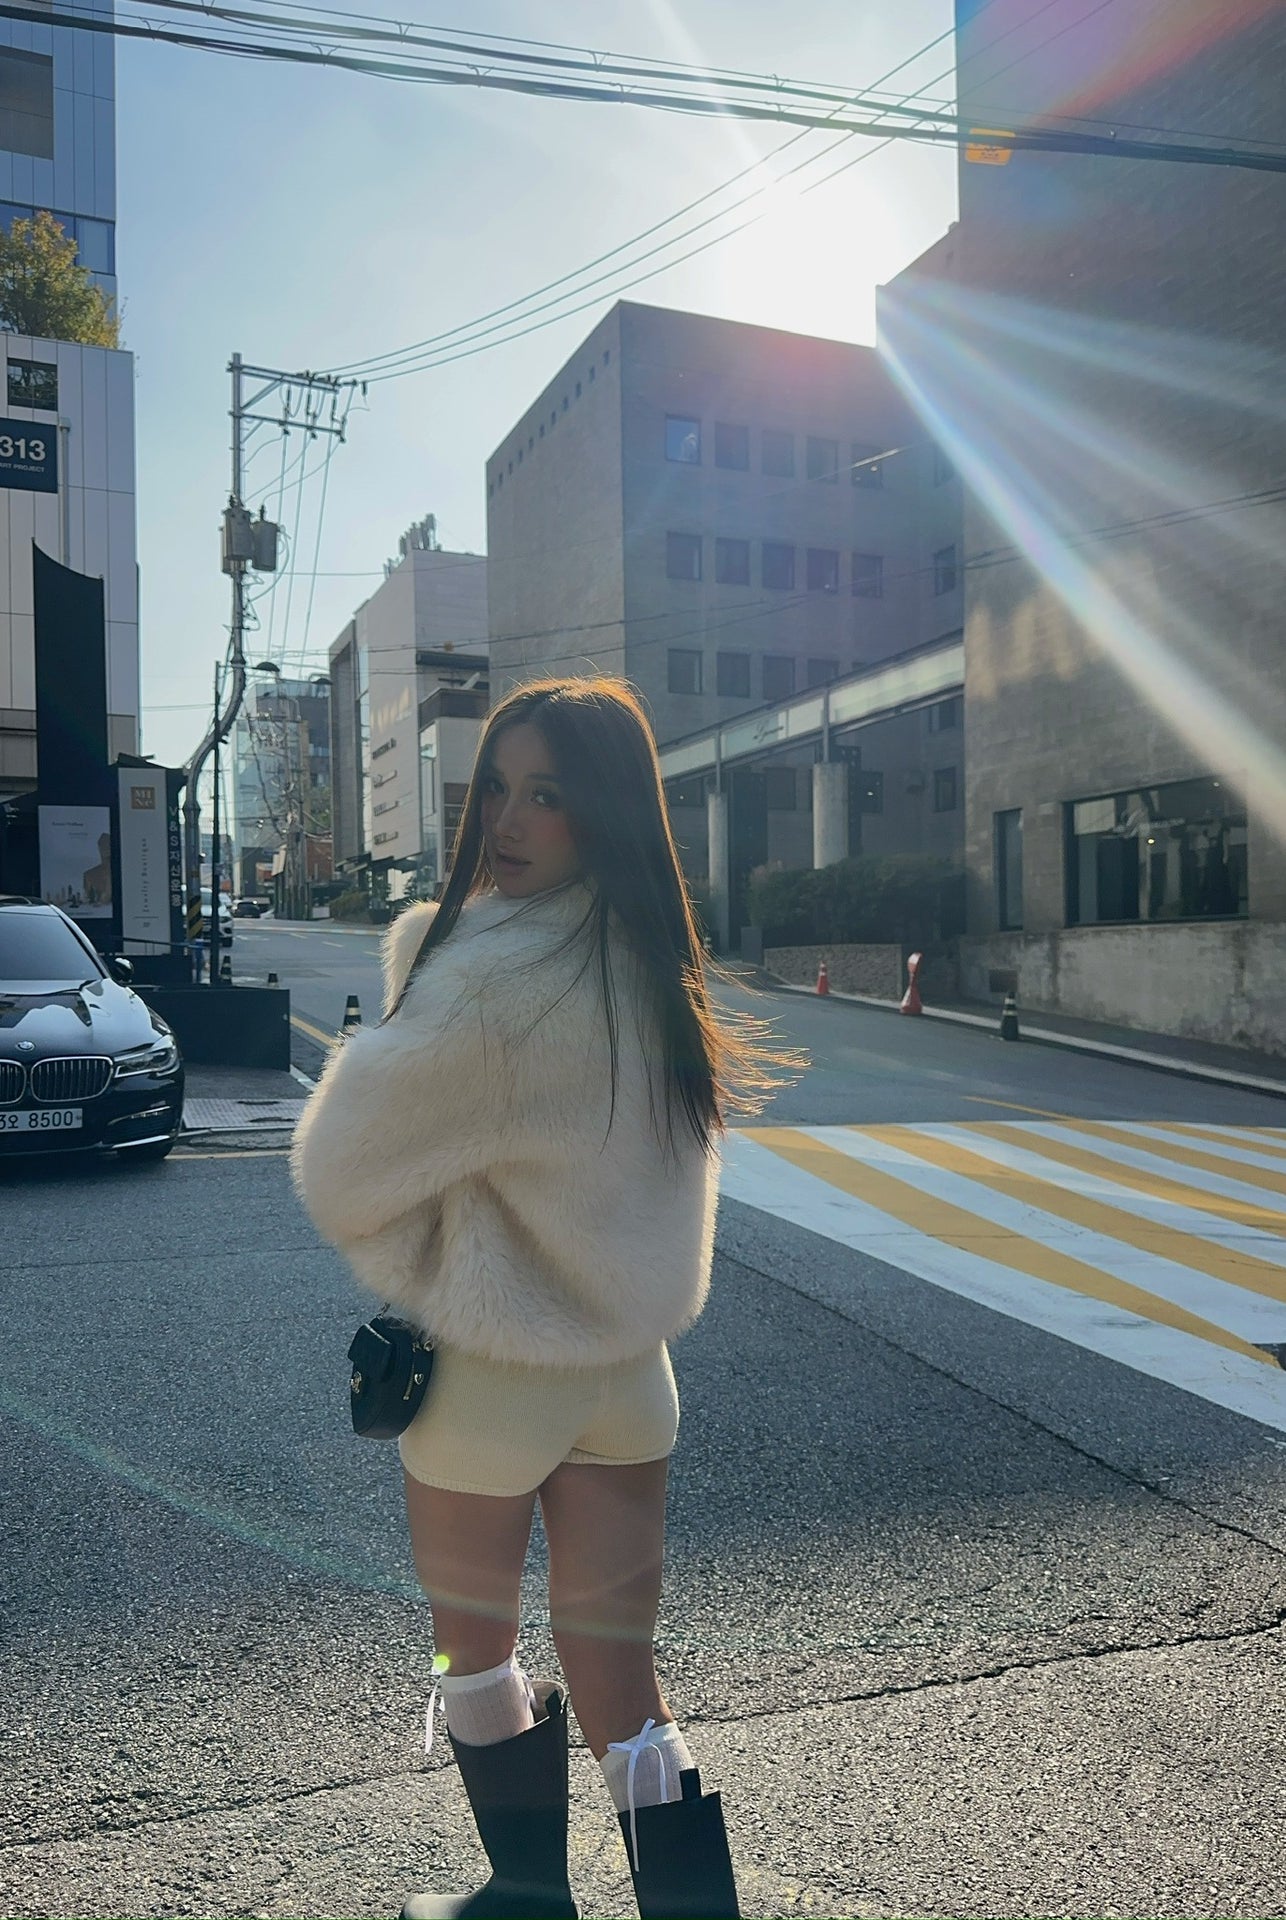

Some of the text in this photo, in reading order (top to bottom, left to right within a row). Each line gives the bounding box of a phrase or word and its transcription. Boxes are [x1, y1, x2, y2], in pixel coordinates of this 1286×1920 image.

[0, 436, 46, 461] 313
[13, 463, 45, 473] PROJECT
[28, 1111, 73, 1129] 8500
